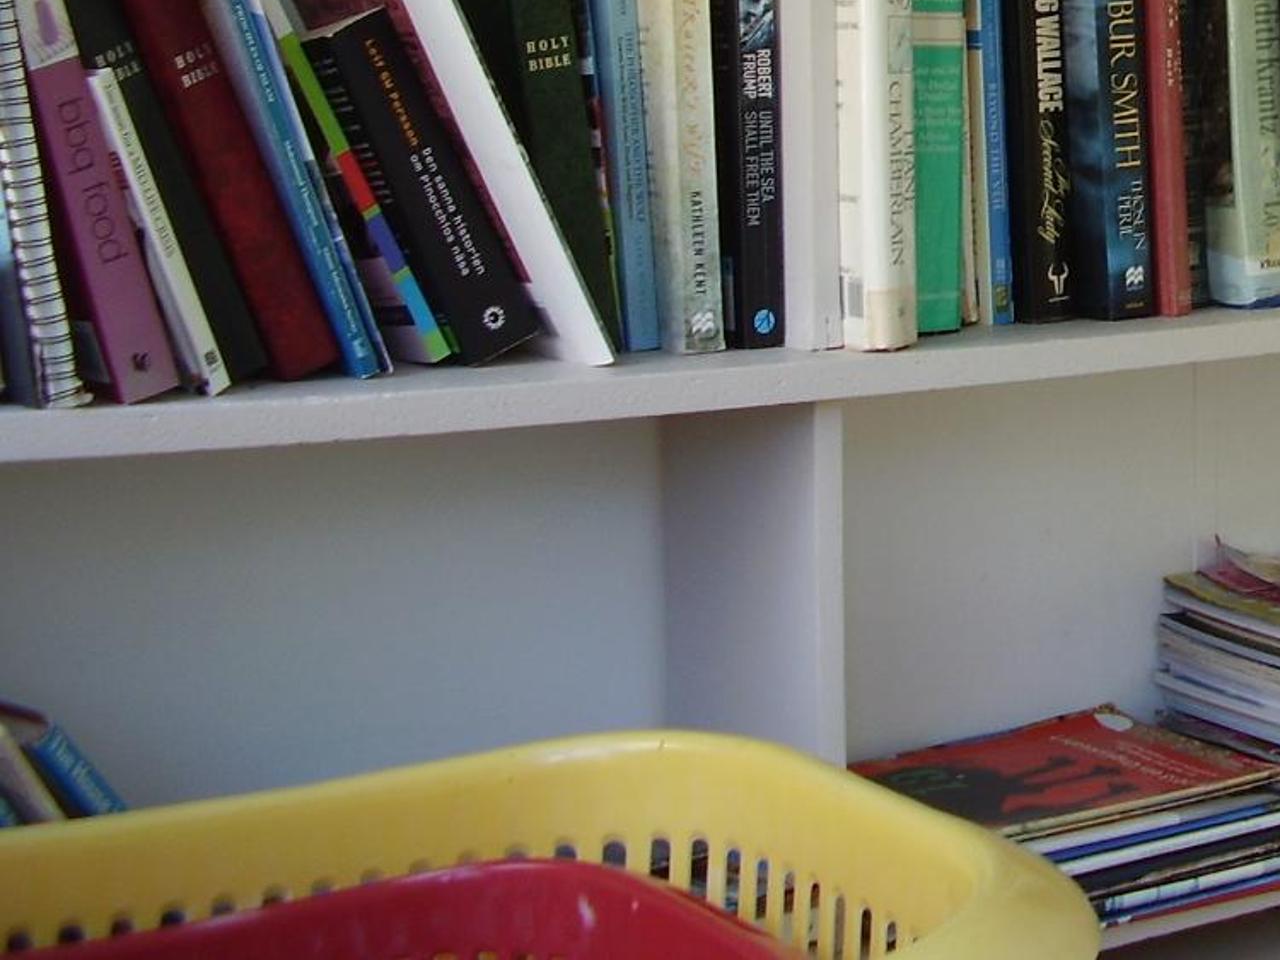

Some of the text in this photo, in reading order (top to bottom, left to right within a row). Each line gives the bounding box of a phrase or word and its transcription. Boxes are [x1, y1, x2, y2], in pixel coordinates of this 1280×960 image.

[95, 41, 134, 68] HOLY
[116, 61, 141, 81] BLE
[174, 43, 213, 69] HOLY
[181, 61, 218, 88] BIBLE
[526, 36, 569, 54] HOLY
[529, 53, 572, 71] BIBLE
[741, 52, 759, 98] FRUMP
[755, 49, 773, 98] ROBERT
[1032, 13, 1065, 113] WALLACE
[390, 91, 422, 148] Persson
[624, 55, 641, 137] PHILOSOPHER
[984, 81, 1001, 142] BEYOND
[1107, 72, 1142, 169] SMITH
[57, 98, 95, 175] bbq
[82, 182, 128, 263] food
[742, 110, 760, 226] SHALL FREE THEM
[757, 110, 774, 202] UNTIL THE SEA
[885, 80, 906, 266] CHAMBERLAIN
[988, 146, 1003, 173] THE
[1034, 118, 1067, 245] Second Lady
[410, 152, 423, 172] om
[420, 174, 455, 242] Pinocchios
[422, 147, 488, 277] Den sanna historien
[1117, 195, 1132, 240] PERIL
[1131, 179, 1147, 249] THOSE IN
[689, 190, 708, 295] KATHLEEN KENT
